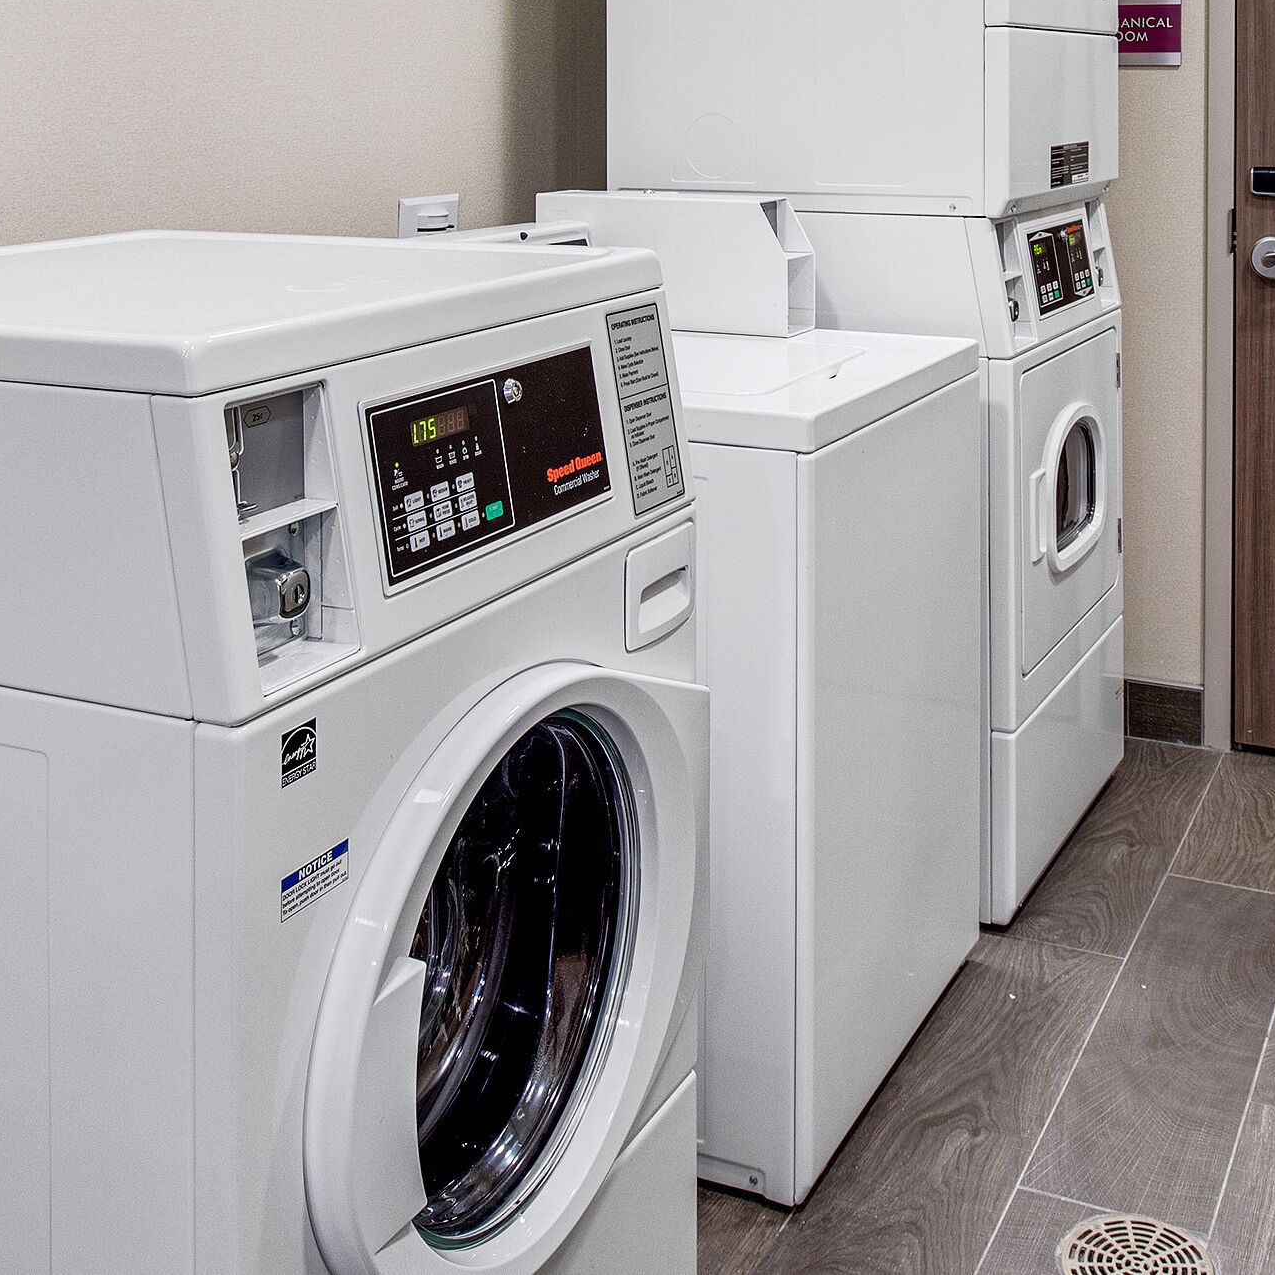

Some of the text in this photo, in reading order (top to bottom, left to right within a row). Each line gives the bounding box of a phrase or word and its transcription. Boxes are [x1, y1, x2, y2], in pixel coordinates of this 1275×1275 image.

[1118, 16, 1173, 29] ANICAL
[610, 313, 654, 330] OPERATING INSTRUCTIONS
[623, 391, 666, 412] DISPENSER INSTRUCTIONS
[412, 418, 437, 444] 1.75
[546, 451, 602, 483] Speed Queen
[554, 469, 600, 496] Commercial Washer
[282, 761, 316, 787] ENERGY STAR
[298, 850, 333, 881] NOTICE
[282, 888, 294, 901] DOOR
[295, 880, 307, 893] LOCK
[307, 872, 319, 885] LIGHT
